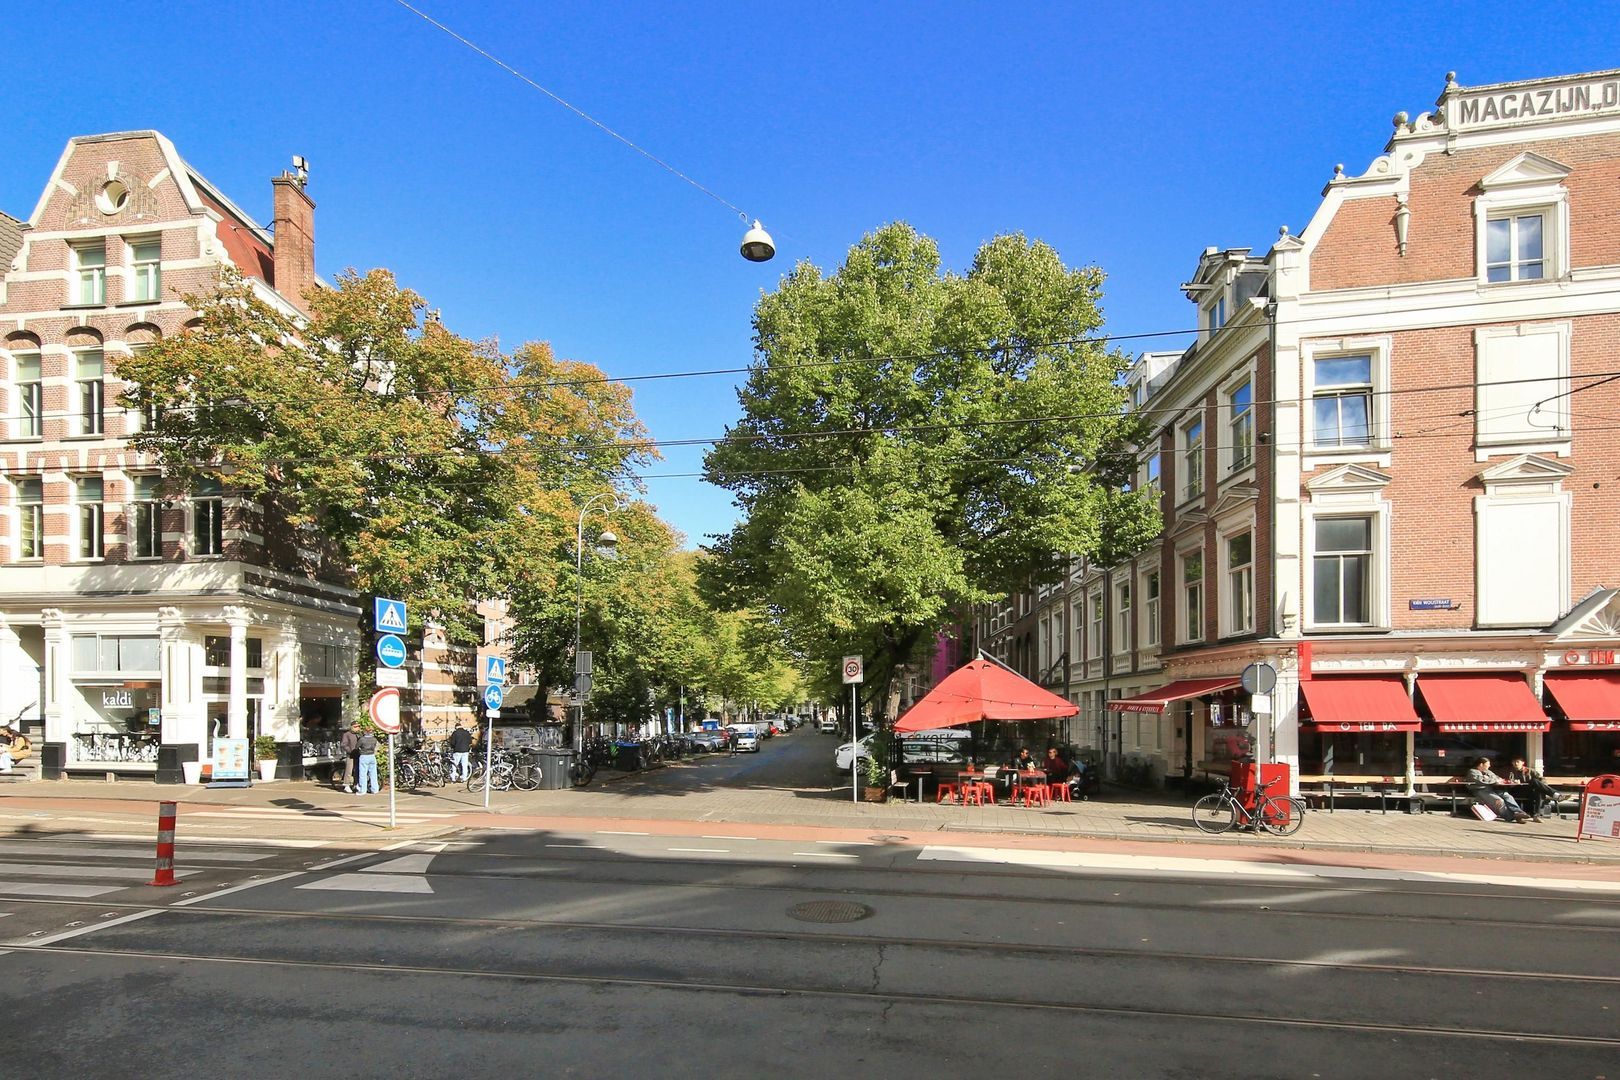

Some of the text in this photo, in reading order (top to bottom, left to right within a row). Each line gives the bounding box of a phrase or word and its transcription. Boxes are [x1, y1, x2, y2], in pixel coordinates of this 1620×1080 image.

[1460, 85, 1591, 125] MAGAZIJN
[102, 690, 132, 706] kaldi
[1358, 721, 1375, 731] TEM
[1444, 722, 1477, 730] RAMEN
